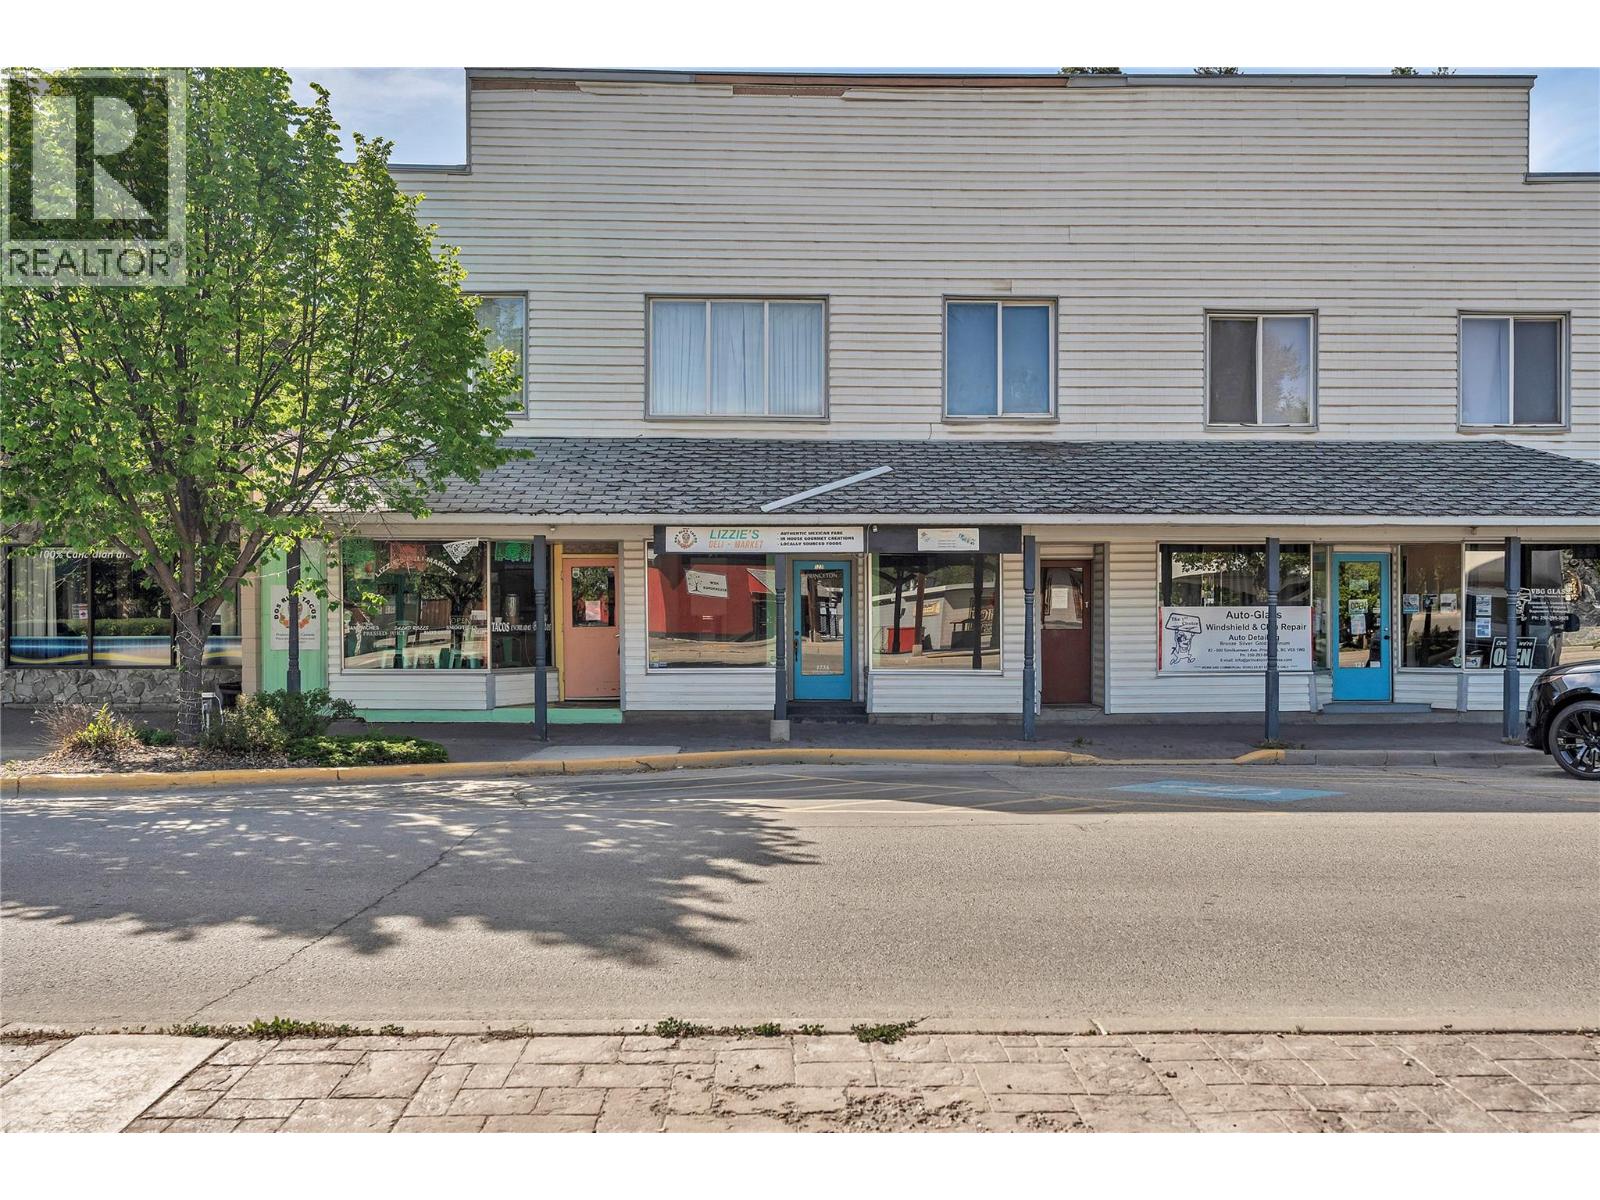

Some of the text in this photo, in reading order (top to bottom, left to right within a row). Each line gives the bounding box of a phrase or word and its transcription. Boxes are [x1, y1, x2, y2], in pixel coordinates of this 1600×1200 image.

[710, 529, 760, 539] LIZZIE'S
[708, 540, 724, 549] DELI
[735, 540, 764, 549] MARKET
[40, 550, 63, 559] 100%
[273, 603, 282, 620] DOS
[302, 596, 317, 620] TACOS
[1226, 610, 1282, 620] Auto-Glas
[492, 622, 510, 632] TACOS
[1206, 623, 1250, 631] Windshield
[1281, 623, 1307, 632] Repair
[1493, 648, 1532, 666] OEN
